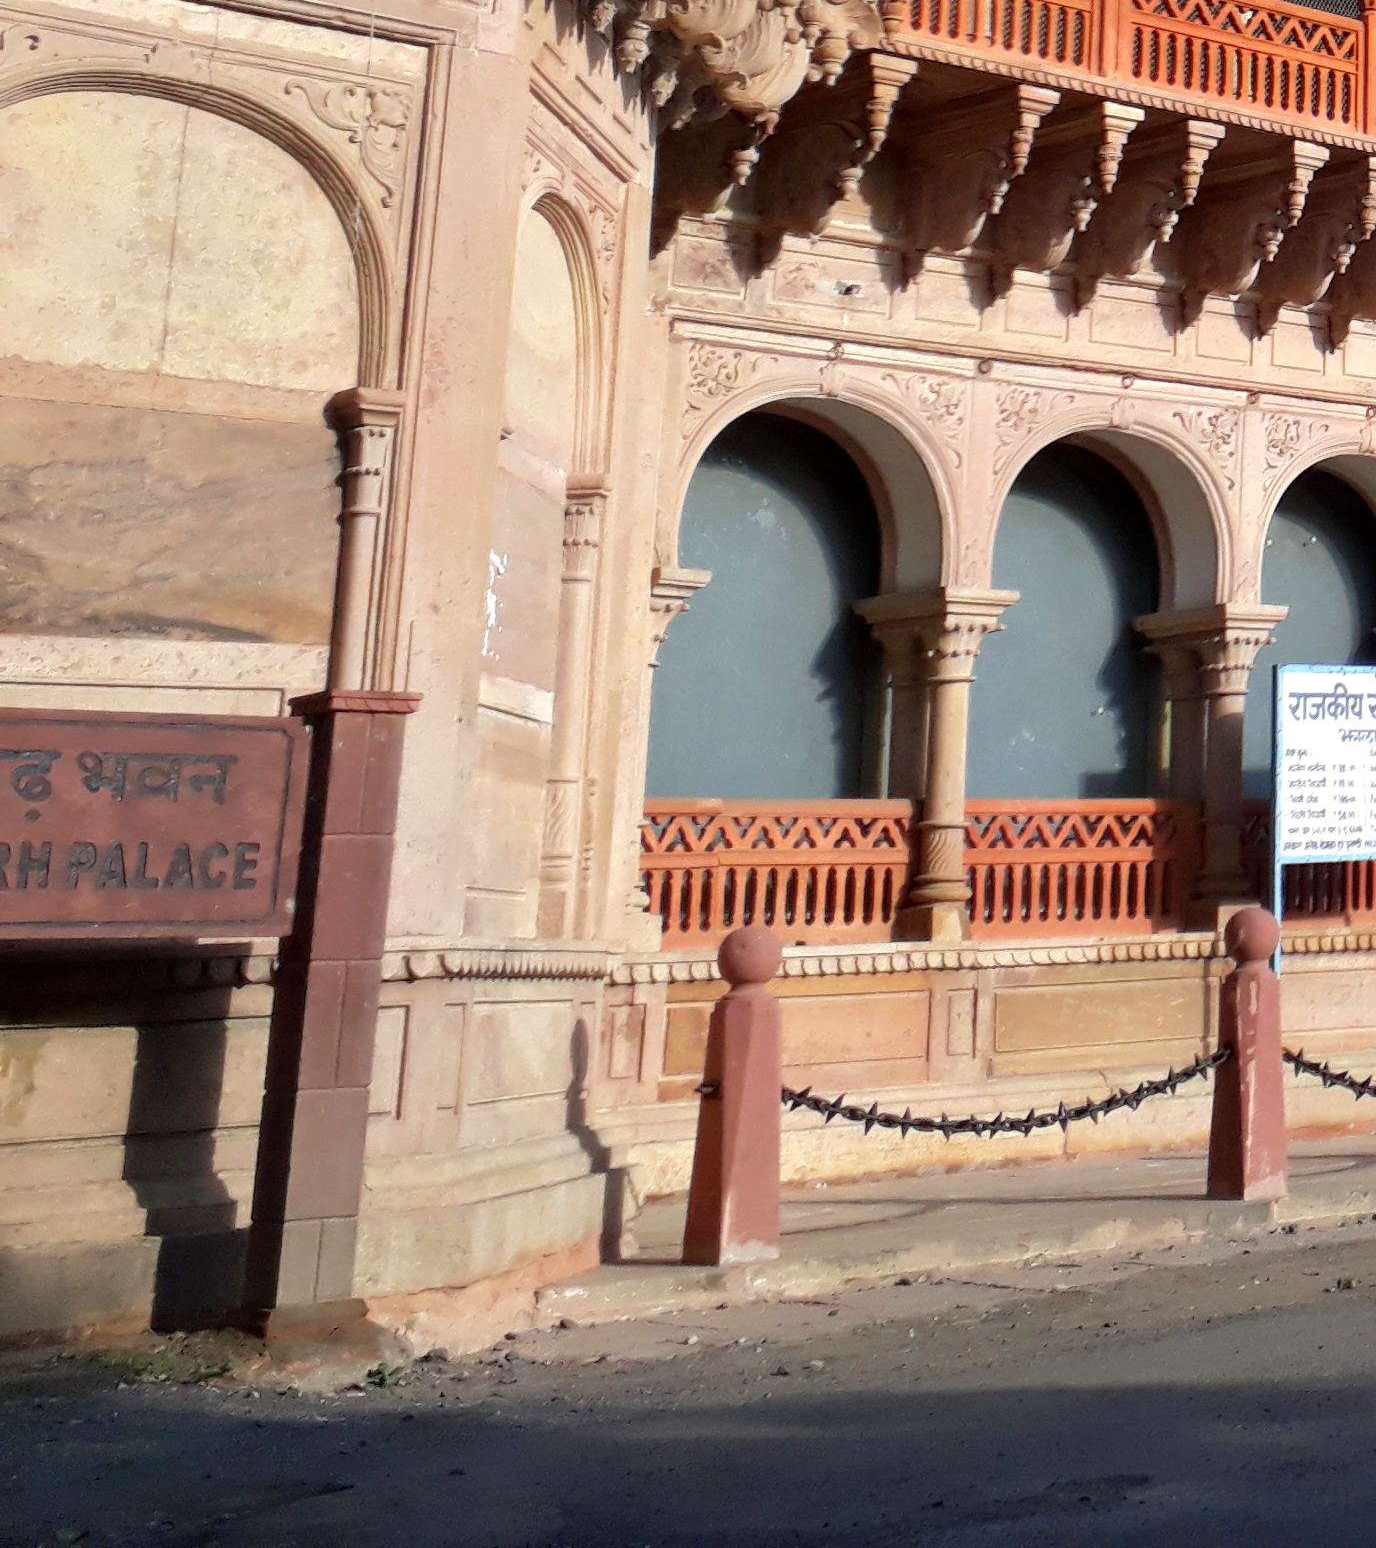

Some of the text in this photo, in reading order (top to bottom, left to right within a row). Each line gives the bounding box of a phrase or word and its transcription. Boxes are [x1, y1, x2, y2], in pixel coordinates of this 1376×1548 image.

[1288, 682, 1364, 721] राजकीय
[0, 749, 238, 823] ढ़ भवन
[68, 841, 260, 890] PALACE
